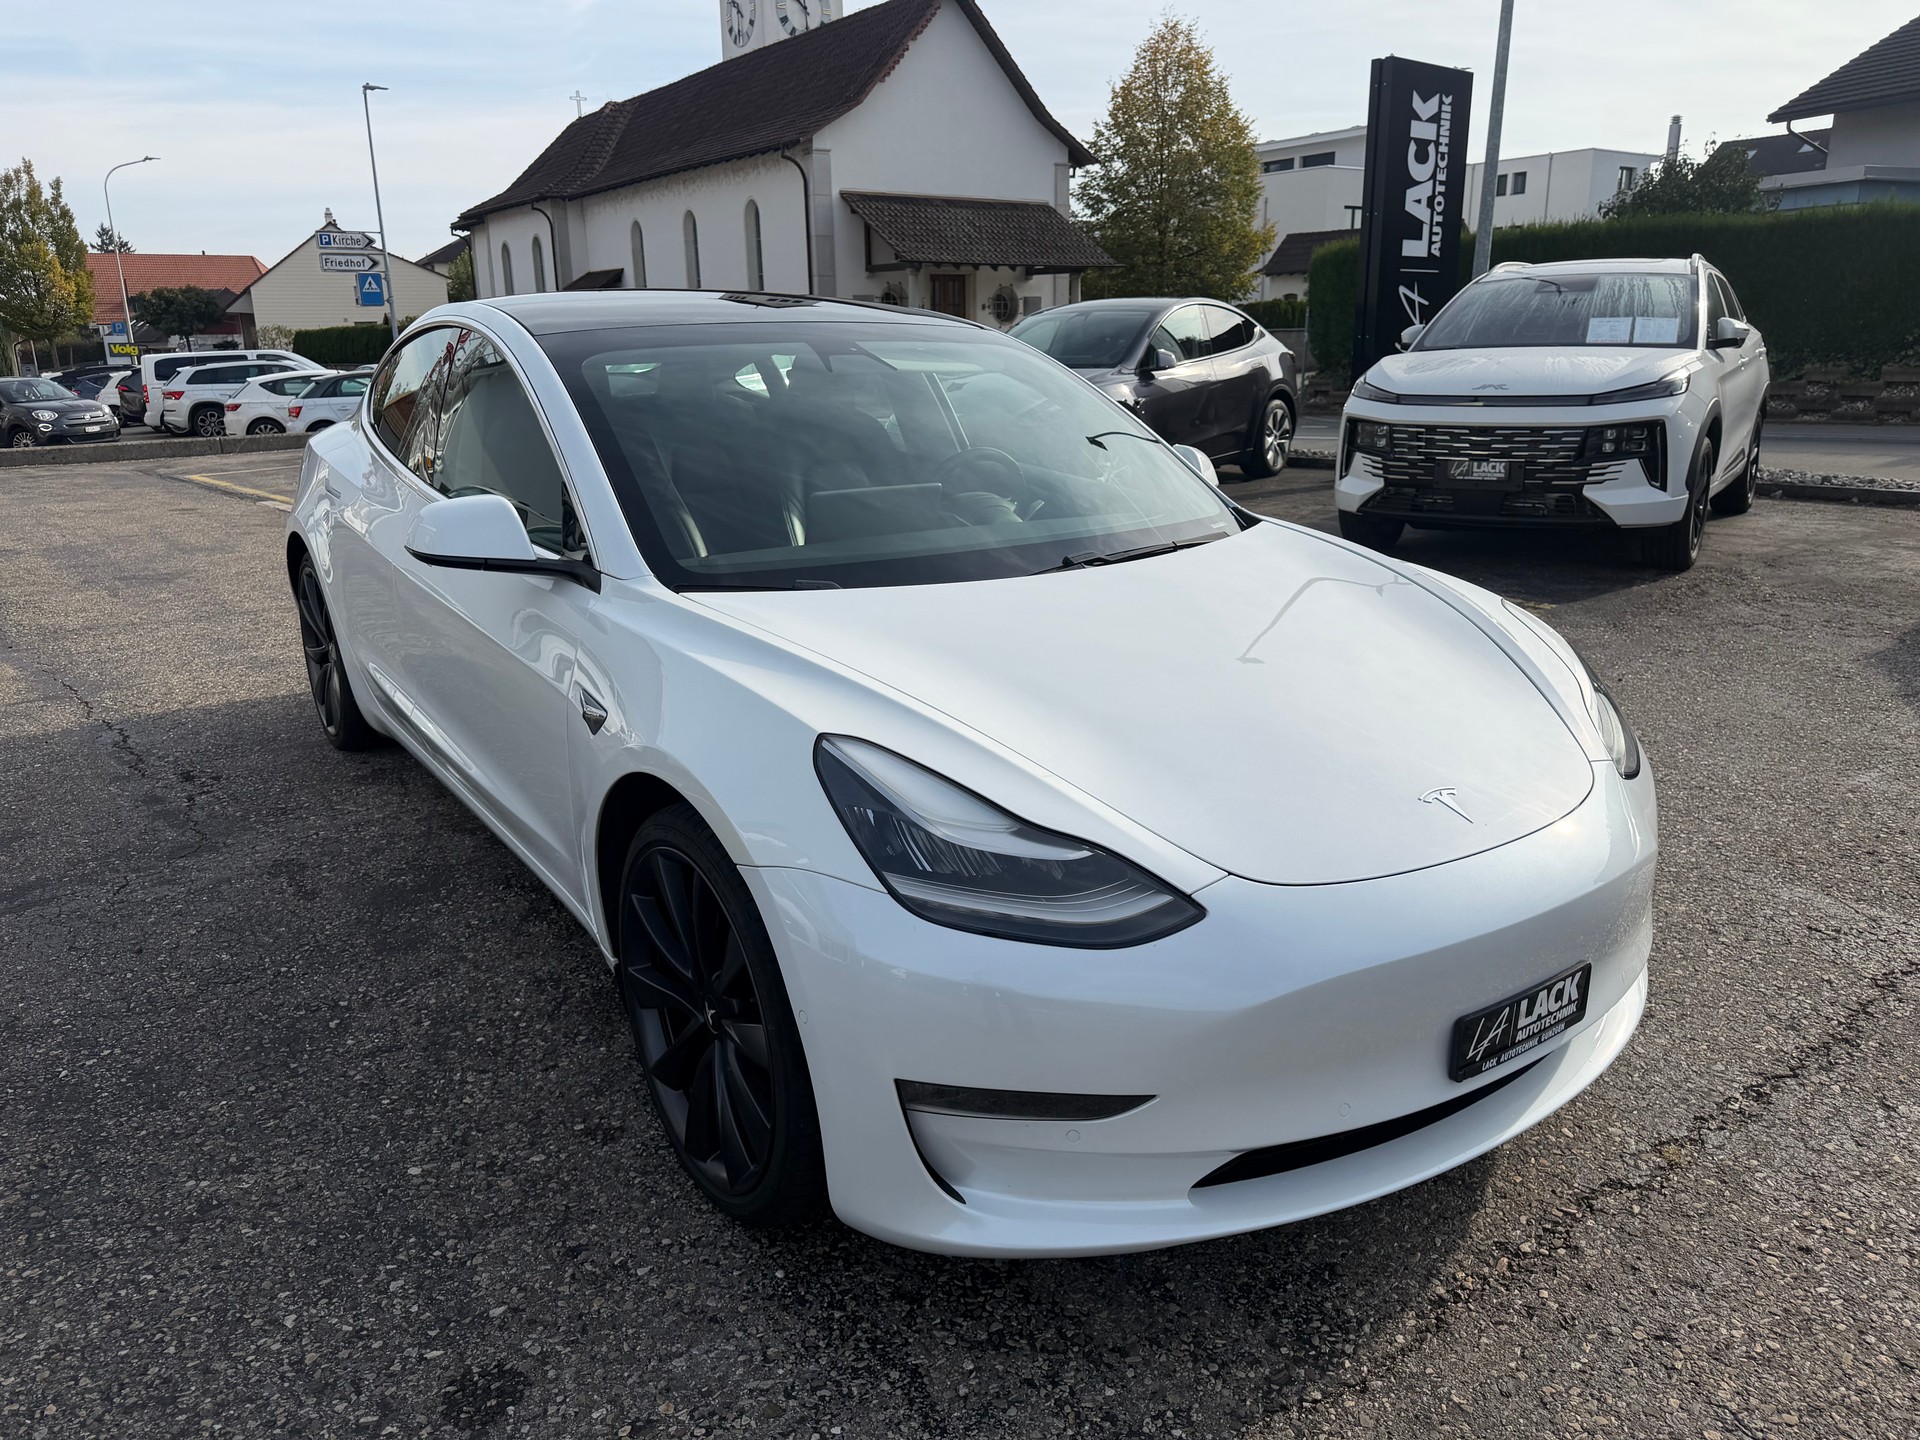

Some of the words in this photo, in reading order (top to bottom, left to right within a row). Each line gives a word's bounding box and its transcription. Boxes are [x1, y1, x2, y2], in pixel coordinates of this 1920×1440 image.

[1402, 90, 1440, 257] LACK
[1430, 94, 1453, 257] AUTOTECHNIK
[332, 234, 361, 246] Kirche
[324, 257, 365, 268] Friedhof
[110, 344, 139, 355] Volg
[1473, 462, 1506, 473] LACK
[1517, 971, 1582, 1029] LACK
[1515, 1001, 1578, 1043] AUTOTECHNIK
[1482, 1058, 1498, 1071] LACK
[1500, 1036, 1539, 1062] AUTOTECHNIK
